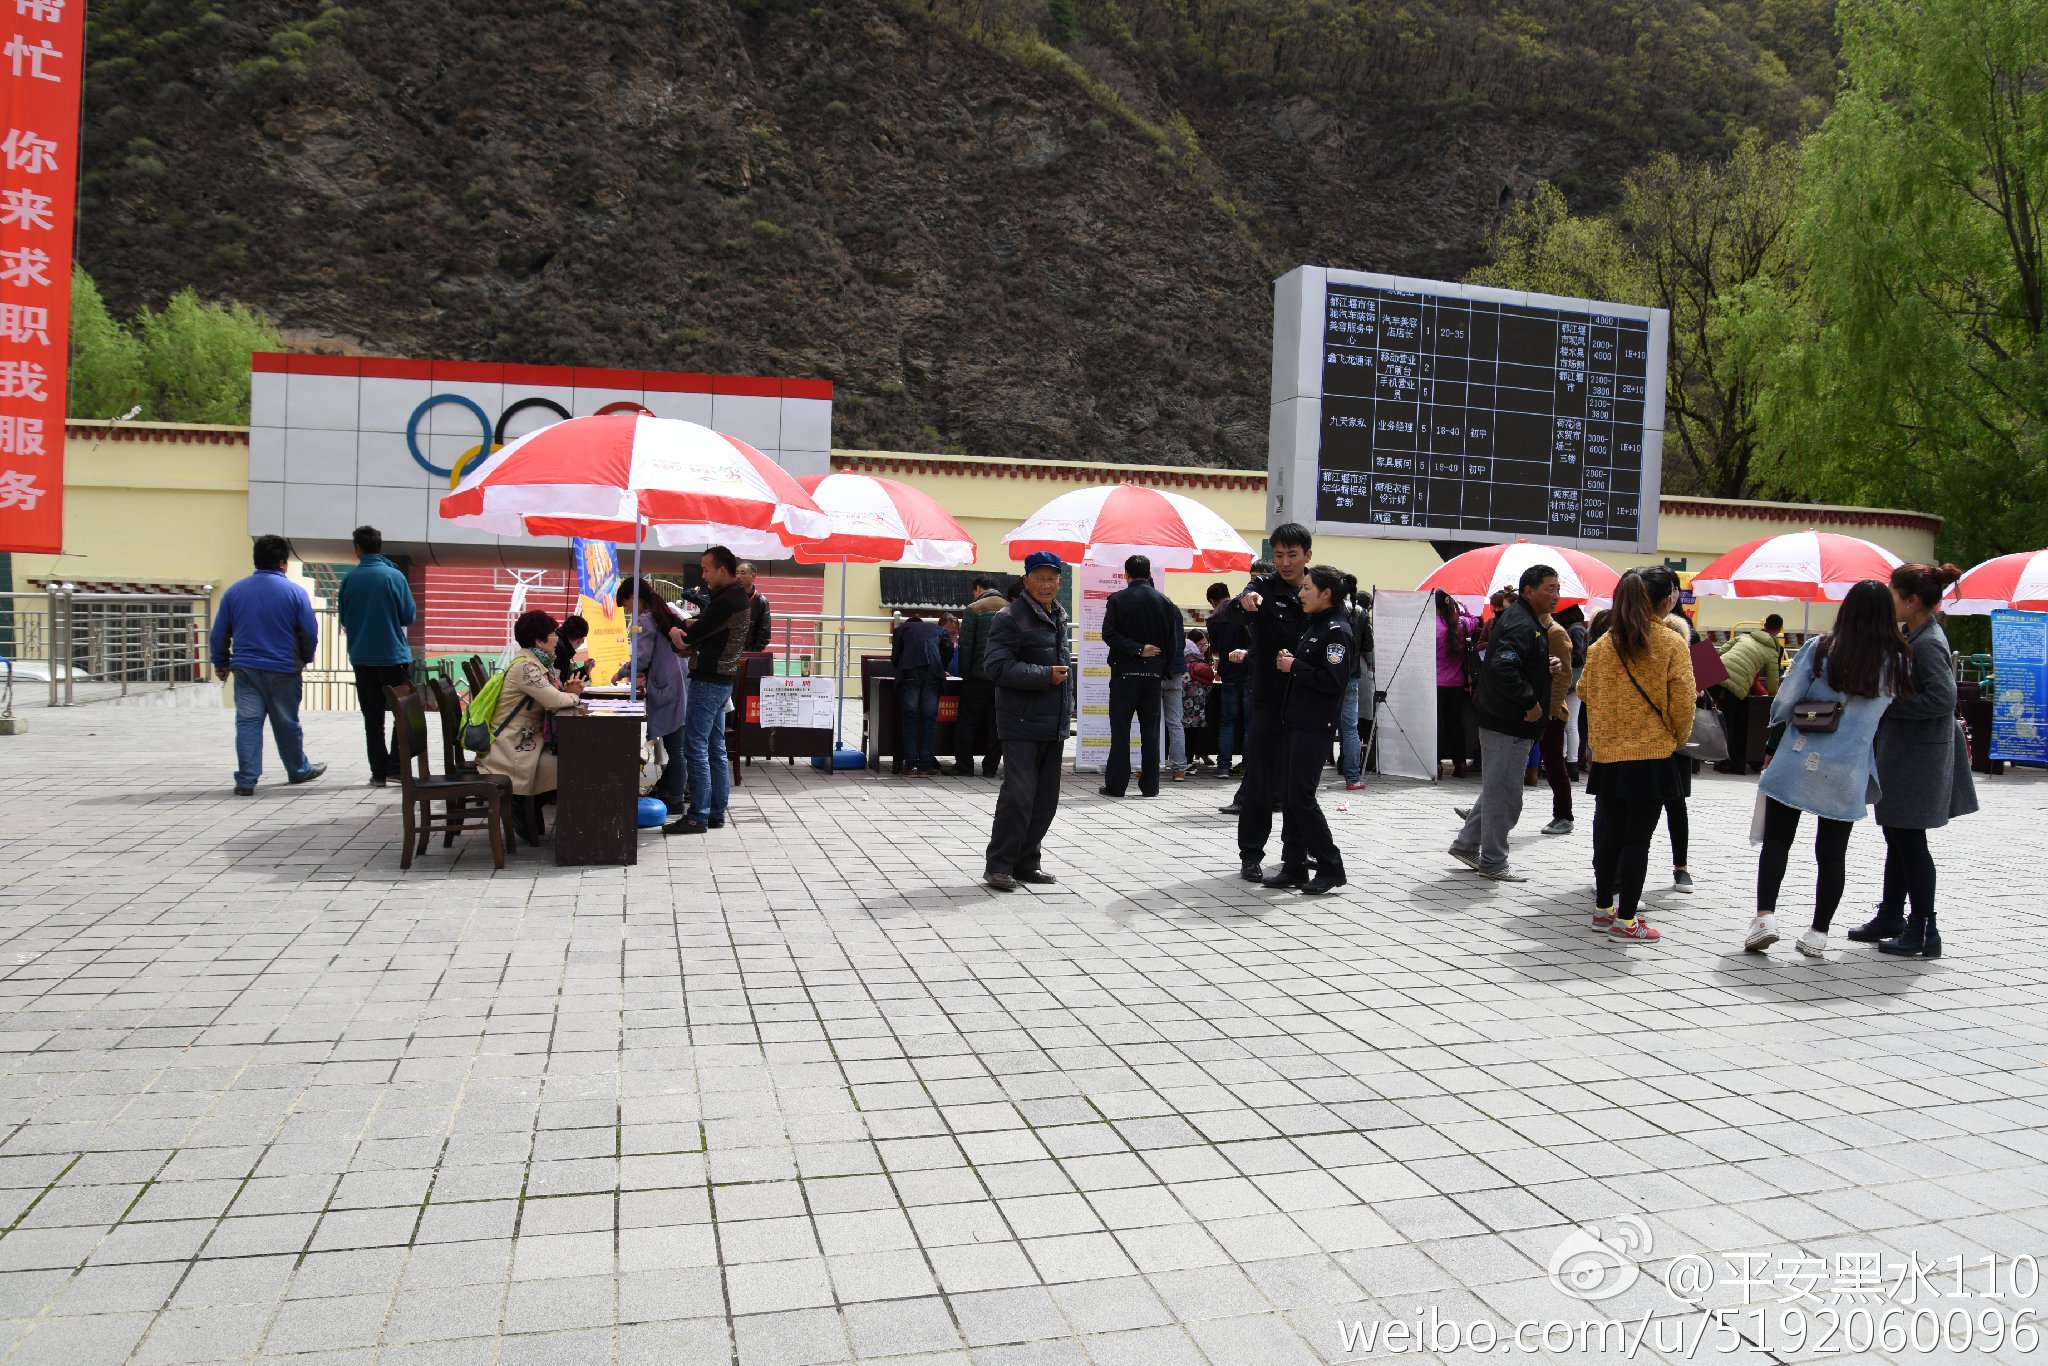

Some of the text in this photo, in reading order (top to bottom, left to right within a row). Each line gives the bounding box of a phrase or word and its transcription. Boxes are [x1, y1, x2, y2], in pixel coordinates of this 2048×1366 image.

[0, 128, 59, 511] 你来求职我服务
[1382, 314, 1418, 328] 汽车美容
[1386, 328, 1414, 339] 店店长
[1440, 328, 1465, 338] 20-35
[1380, 376, 1416, 390] 手机营业
[1378, 420, 1414, 433] 业务经理
[1436, 426, 1460, 436] 18-40
[1470, 428, 1487, 438] 初中
[1376, 456, 1412, 470] 家具顾问
[1468, 465, 1486, 475] 初中
[1379, 494, 1407, 505] 设计师
